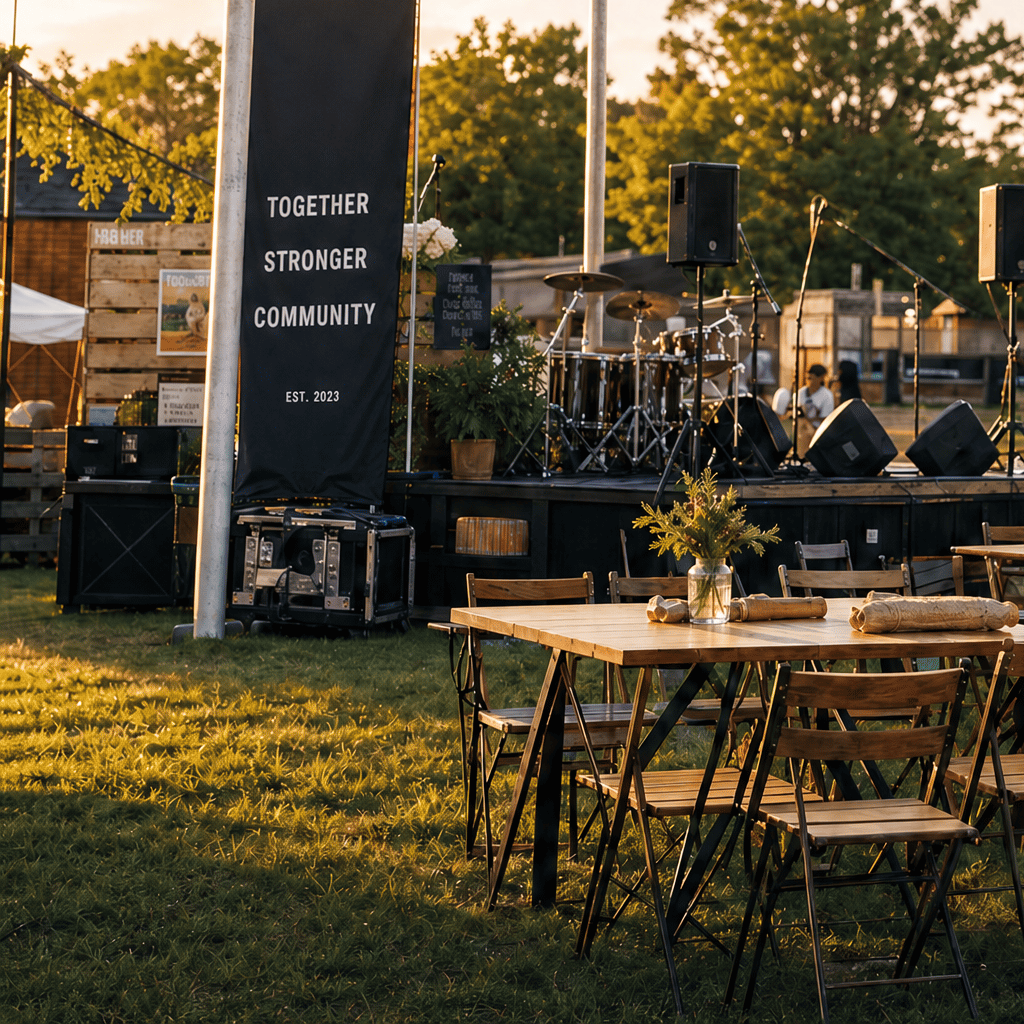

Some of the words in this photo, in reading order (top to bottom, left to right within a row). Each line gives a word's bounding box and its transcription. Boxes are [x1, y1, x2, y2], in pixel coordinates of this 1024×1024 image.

[267, 192, 369, 218] TOGETHER
[264, 247, 367, 272] STRONGER
[254, 302, 376, 328] COMMUNITY
[285, 391, 309, 403] EST.
[313, 390, 340, 403] 2023
